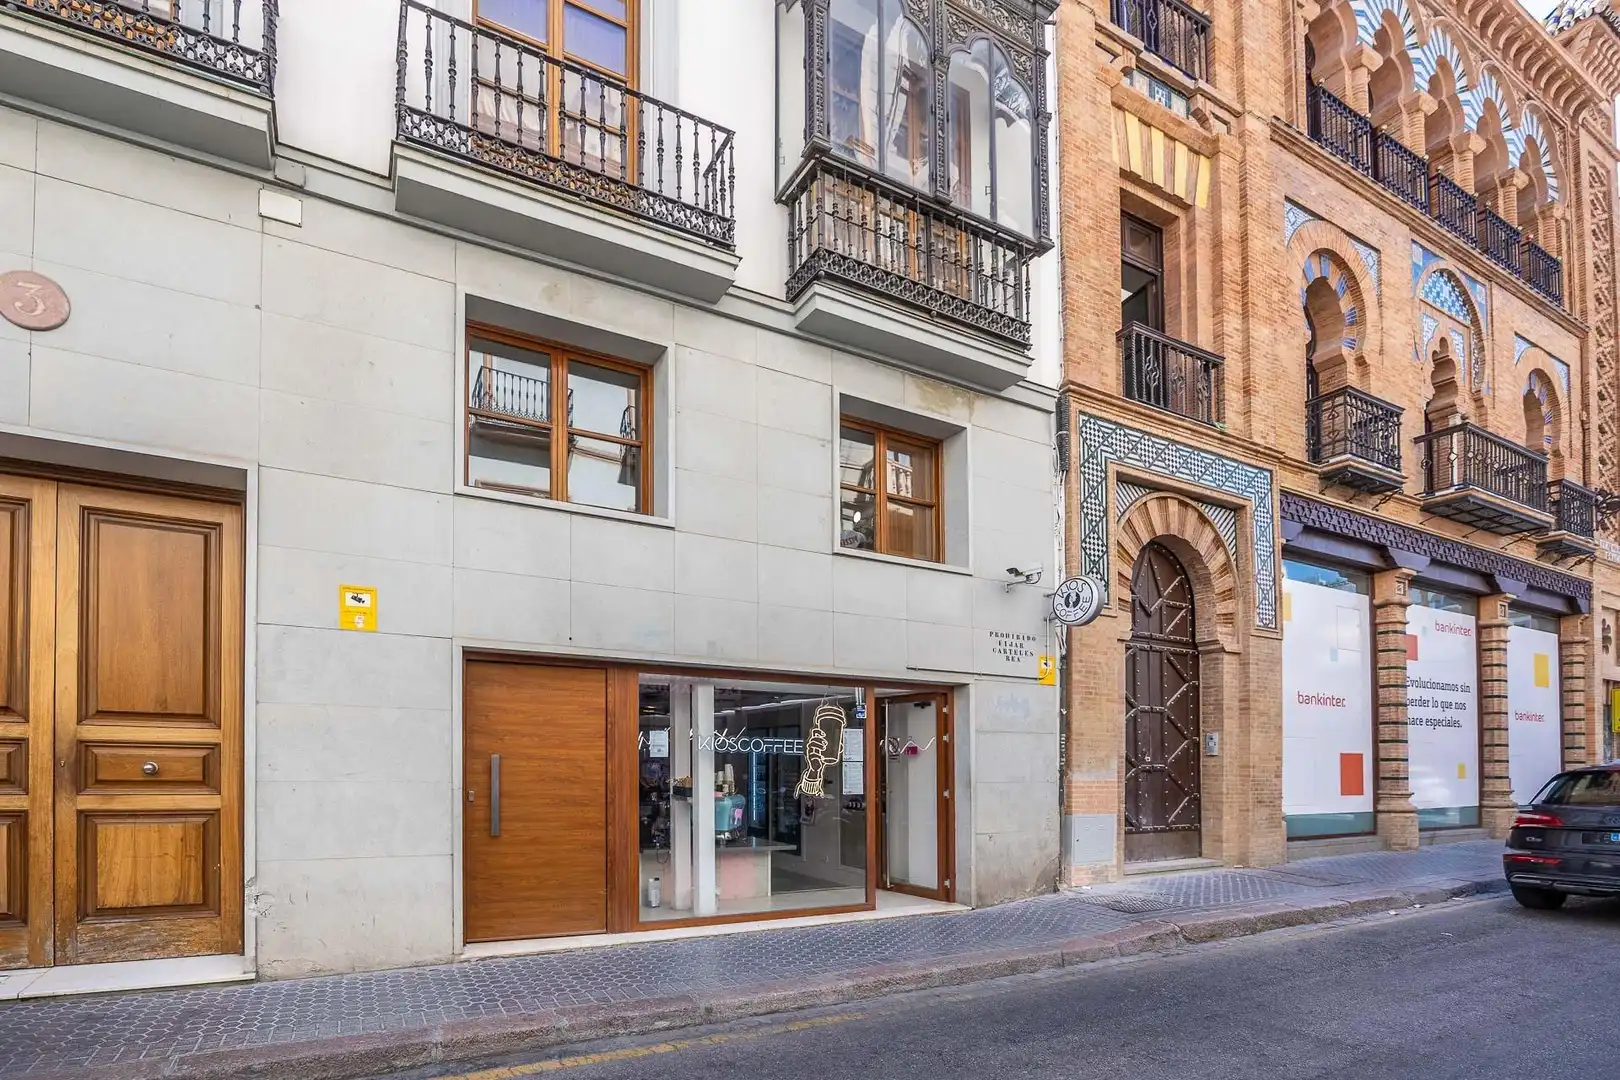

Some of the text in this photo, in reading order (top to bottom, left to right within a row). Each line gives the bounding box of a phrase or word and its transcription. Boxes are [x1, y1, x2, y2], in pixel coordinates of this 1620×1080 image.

[14, 281, 46, 315] 3
[1057, 580, 1087, 598] KIOS
[1055, 596, 1091, 619] COFFEE
[989, 630, 1037, 641] PROHIBIDO
[998, 640, 1024, 648] FIJAR
[992, 647, 1034, 656] CARTELES
[1460, 682, 1471, 693] sin
[1431, 696, 1439, 709] lo
[1440, 700, 1453, 712] que
[1454, 702, 1467, 711] nos
[1425, 717, 1463, 730] especiales.
